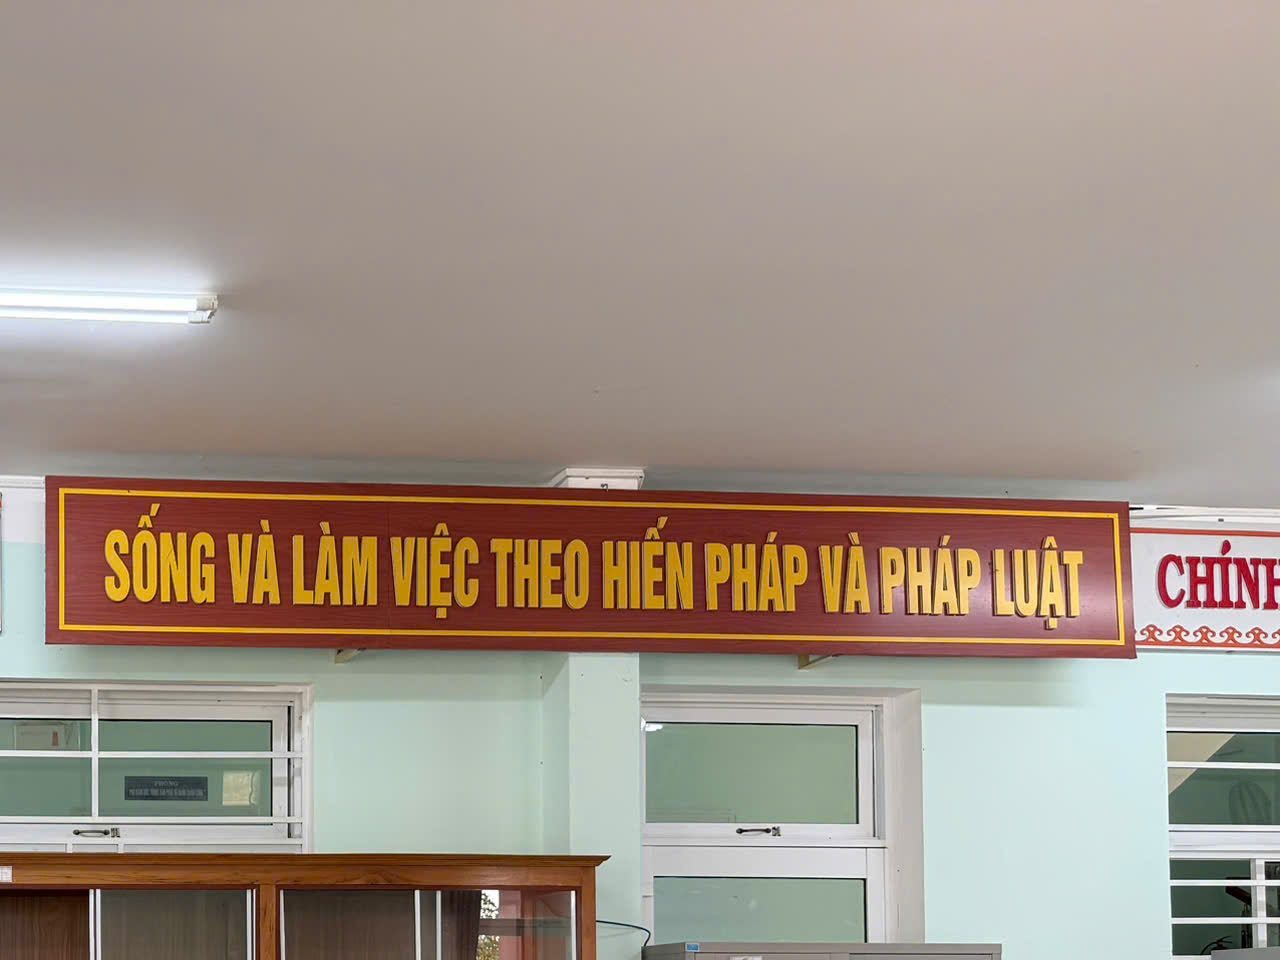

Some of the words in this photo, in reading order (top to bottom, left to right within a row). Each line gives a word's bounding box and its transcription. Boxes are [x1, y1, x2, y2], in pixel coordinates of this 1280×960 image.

[103, 503, 216, 604] SỐNG
[227, 519, 281, 605] VÀ
[292, 521, 378, 607] LÀM
[390, 522, 480, 619] VIỆC
[490, 537, 590, 610] THEO
[602, 516, 694, 611] HIẾN
[706, 531, 808, 612] PHÁP
[821, 531, 872, 614] VÀ
[880, 535, 983, 616] PHÁP
[992, 535, 1084, 630] LUẬT
[1157, 539, 1280, 611] CHÍNH
